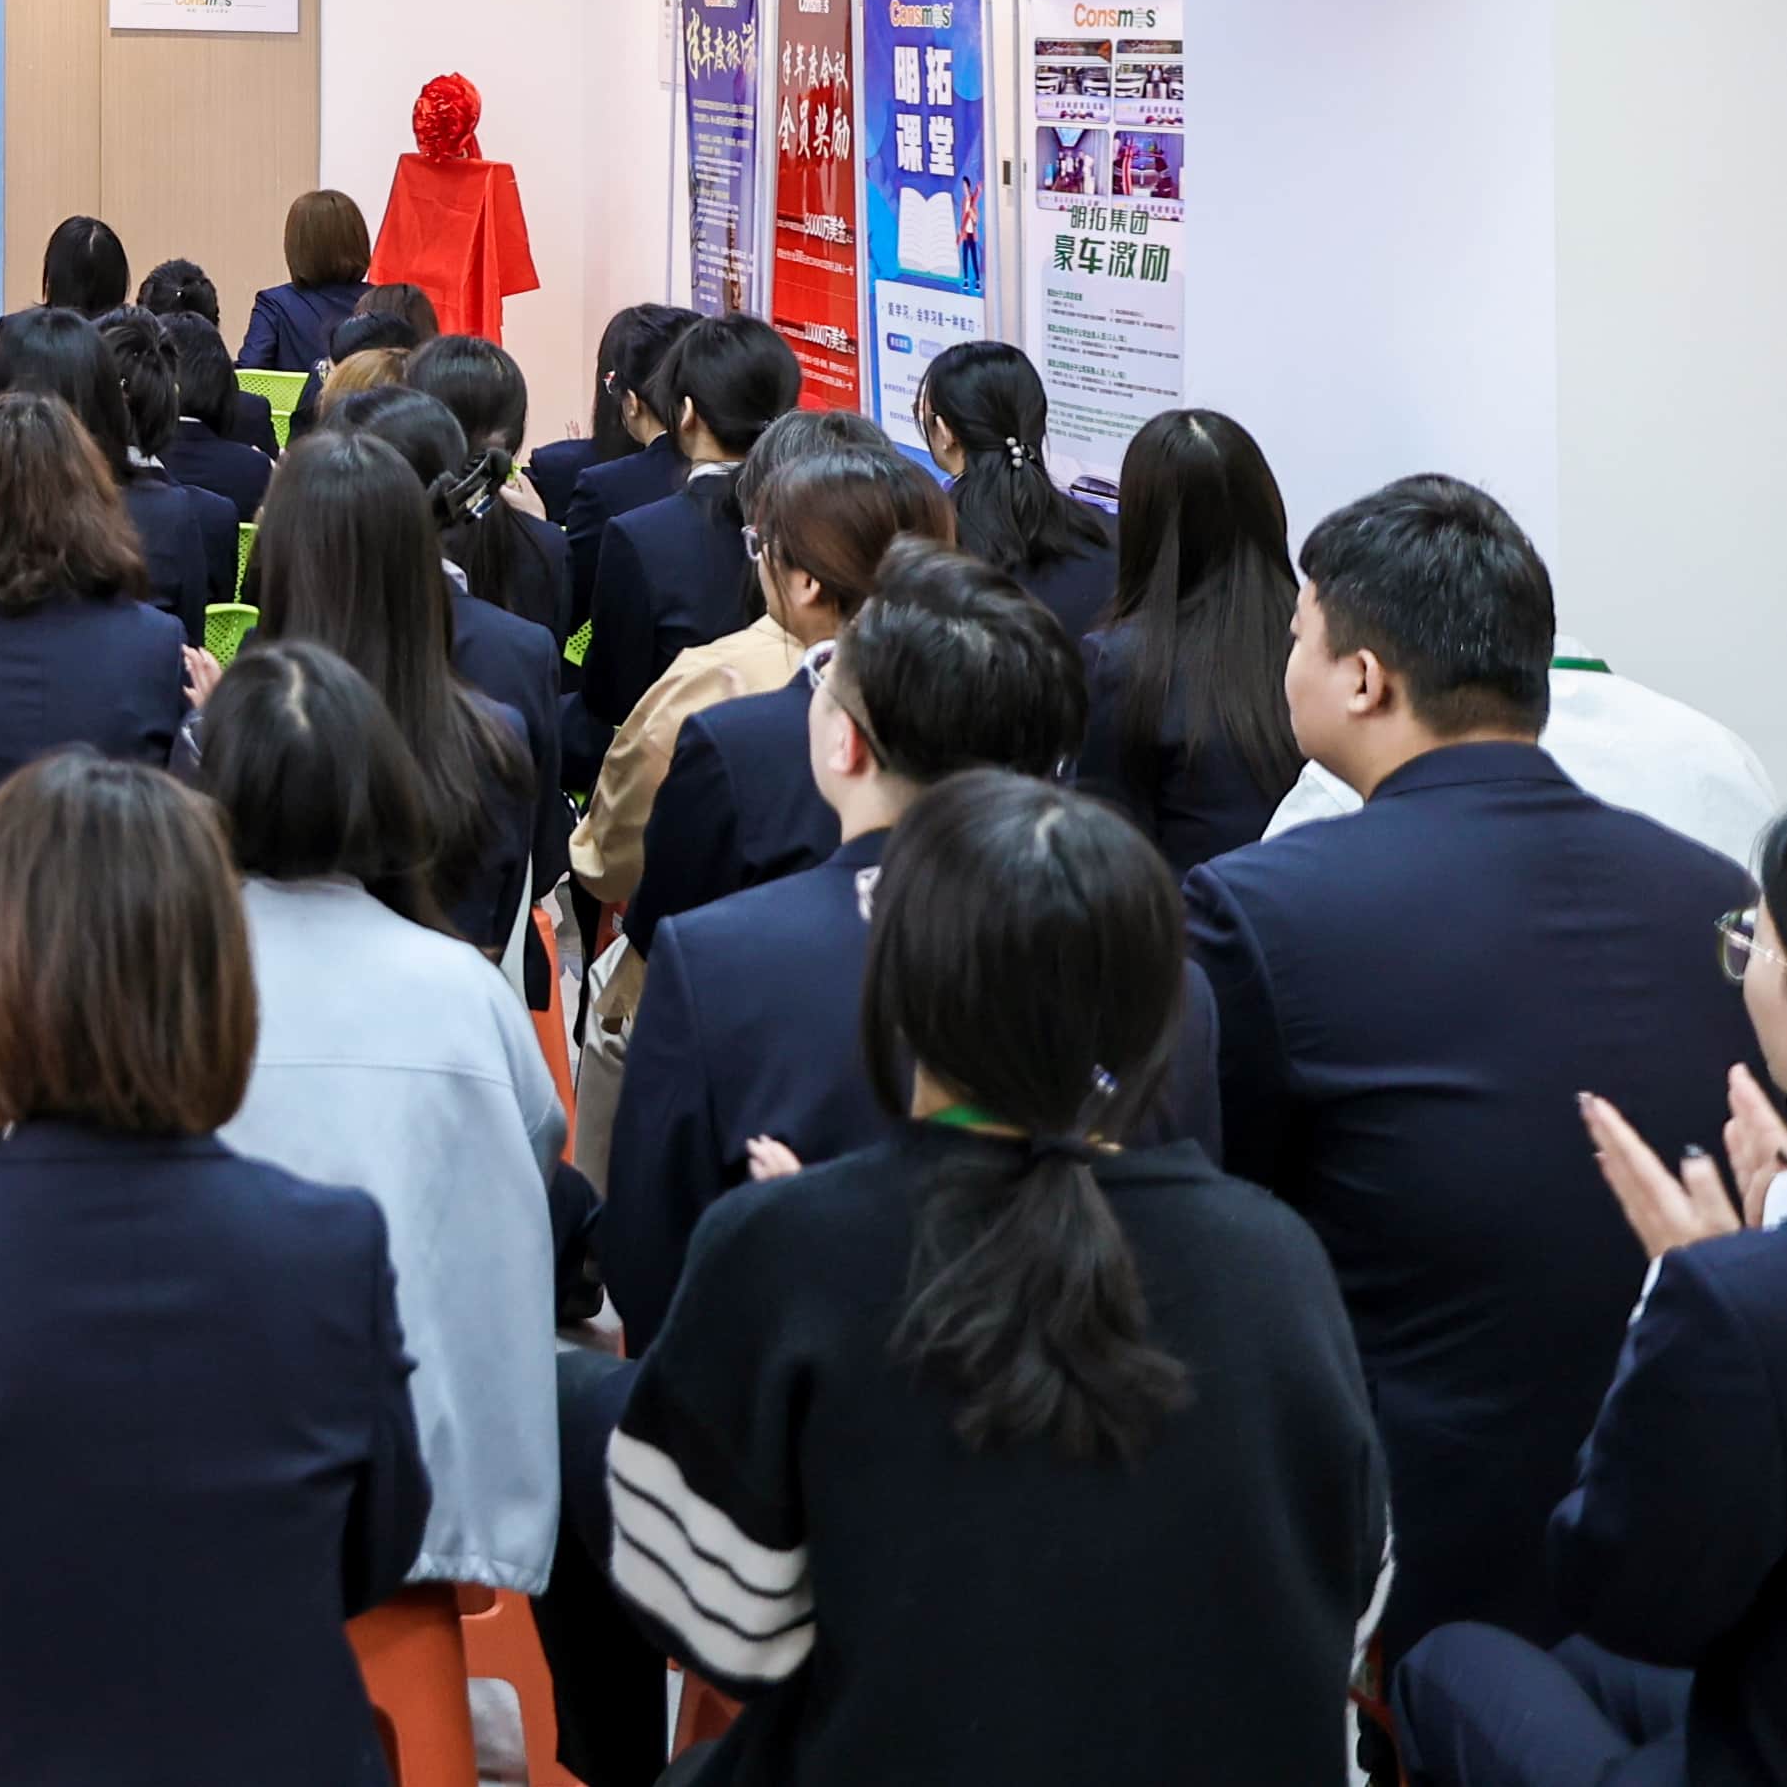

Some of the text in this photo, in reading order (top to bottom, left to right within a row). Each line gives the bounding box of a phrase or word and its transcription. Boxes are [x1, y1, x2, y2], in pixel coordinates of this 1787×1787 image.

[1073, 3, 1157, 29] Consmos
[894, 46, 952, 106] 明拓
[896, 114, 955, 176] 课堂
[1053, 234, 1170, 282] 豪车激励
